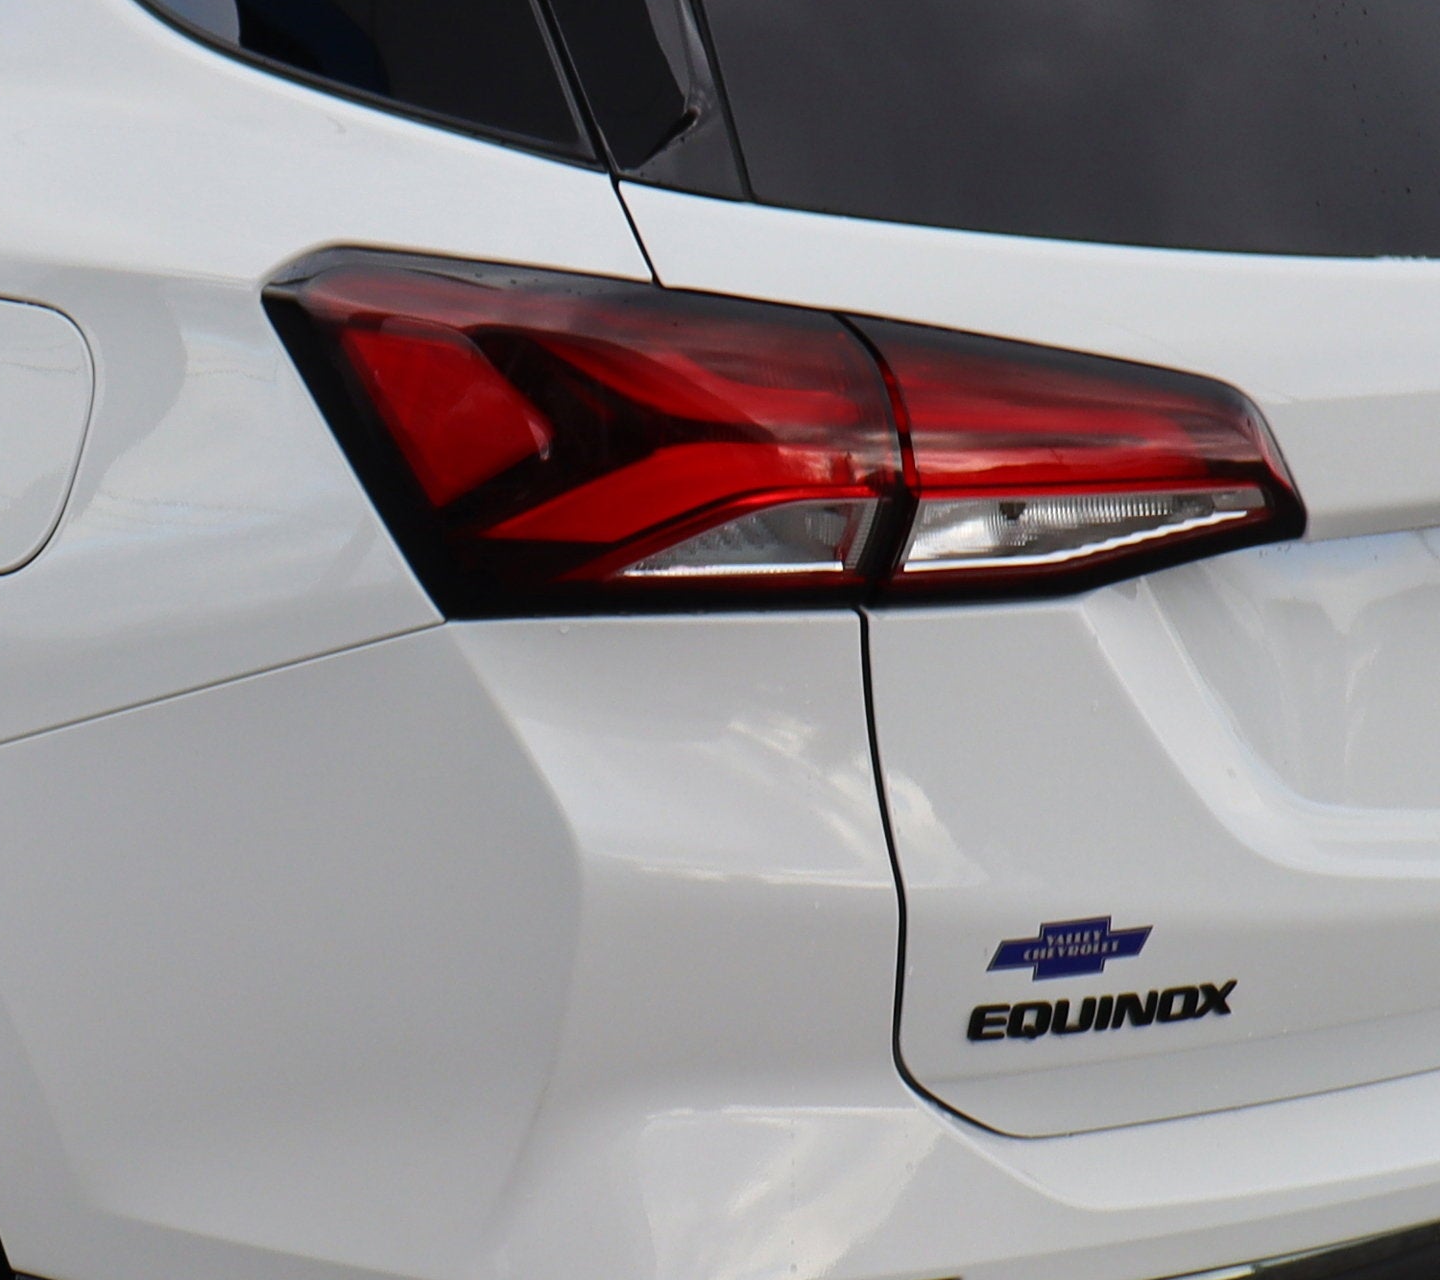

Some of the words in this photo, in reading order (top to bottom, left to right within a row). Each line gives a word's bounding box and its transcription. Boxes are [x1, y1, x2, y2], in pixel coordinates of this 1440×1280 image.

[1046, 929, 1104, 947] VALLEY
[1022, 940, 1120, 962] CHEVROLET
[966, 978, 1239, 1042] EQUINOX
